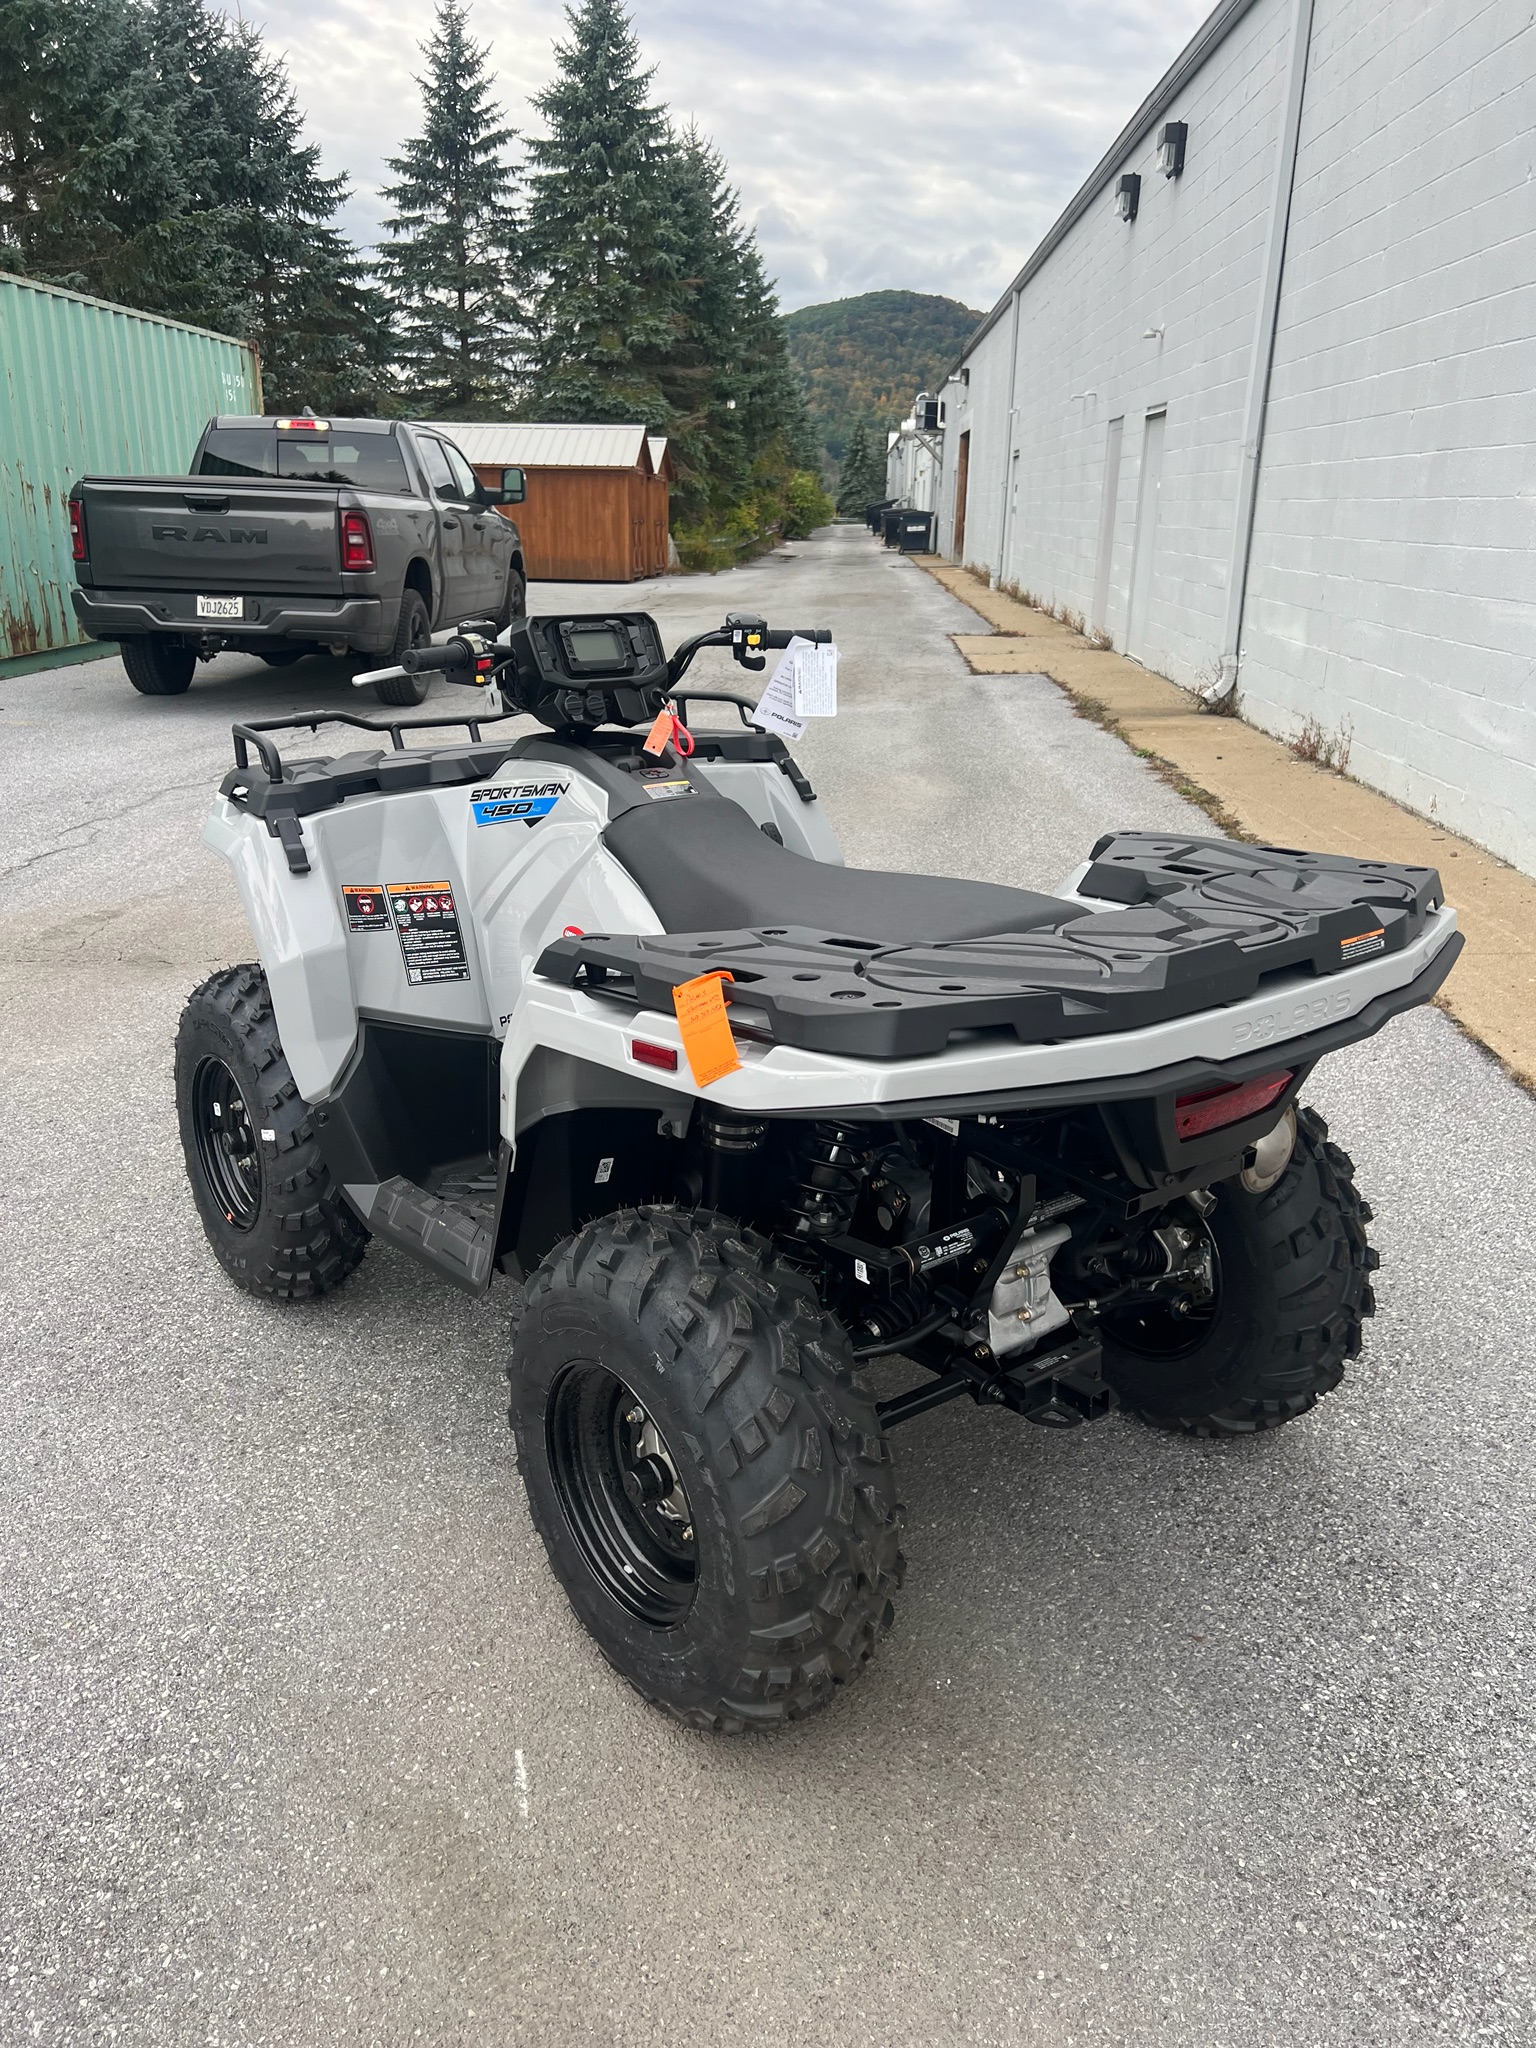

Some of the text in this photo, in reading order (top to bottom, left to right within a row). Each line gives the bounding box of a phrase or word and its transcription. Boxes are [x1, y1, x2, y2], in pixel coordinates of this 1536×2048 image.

[151, 524, 268, 545] RAM
[200, 601, 239, 615] VDJ2625
[770, 711, 803, 728] POLARIS
[469, 782, 571, 802] SPORTSMAN
[482, 801, 534, 817] 450
[1231, 989, 1352, 1051] POLARIS
